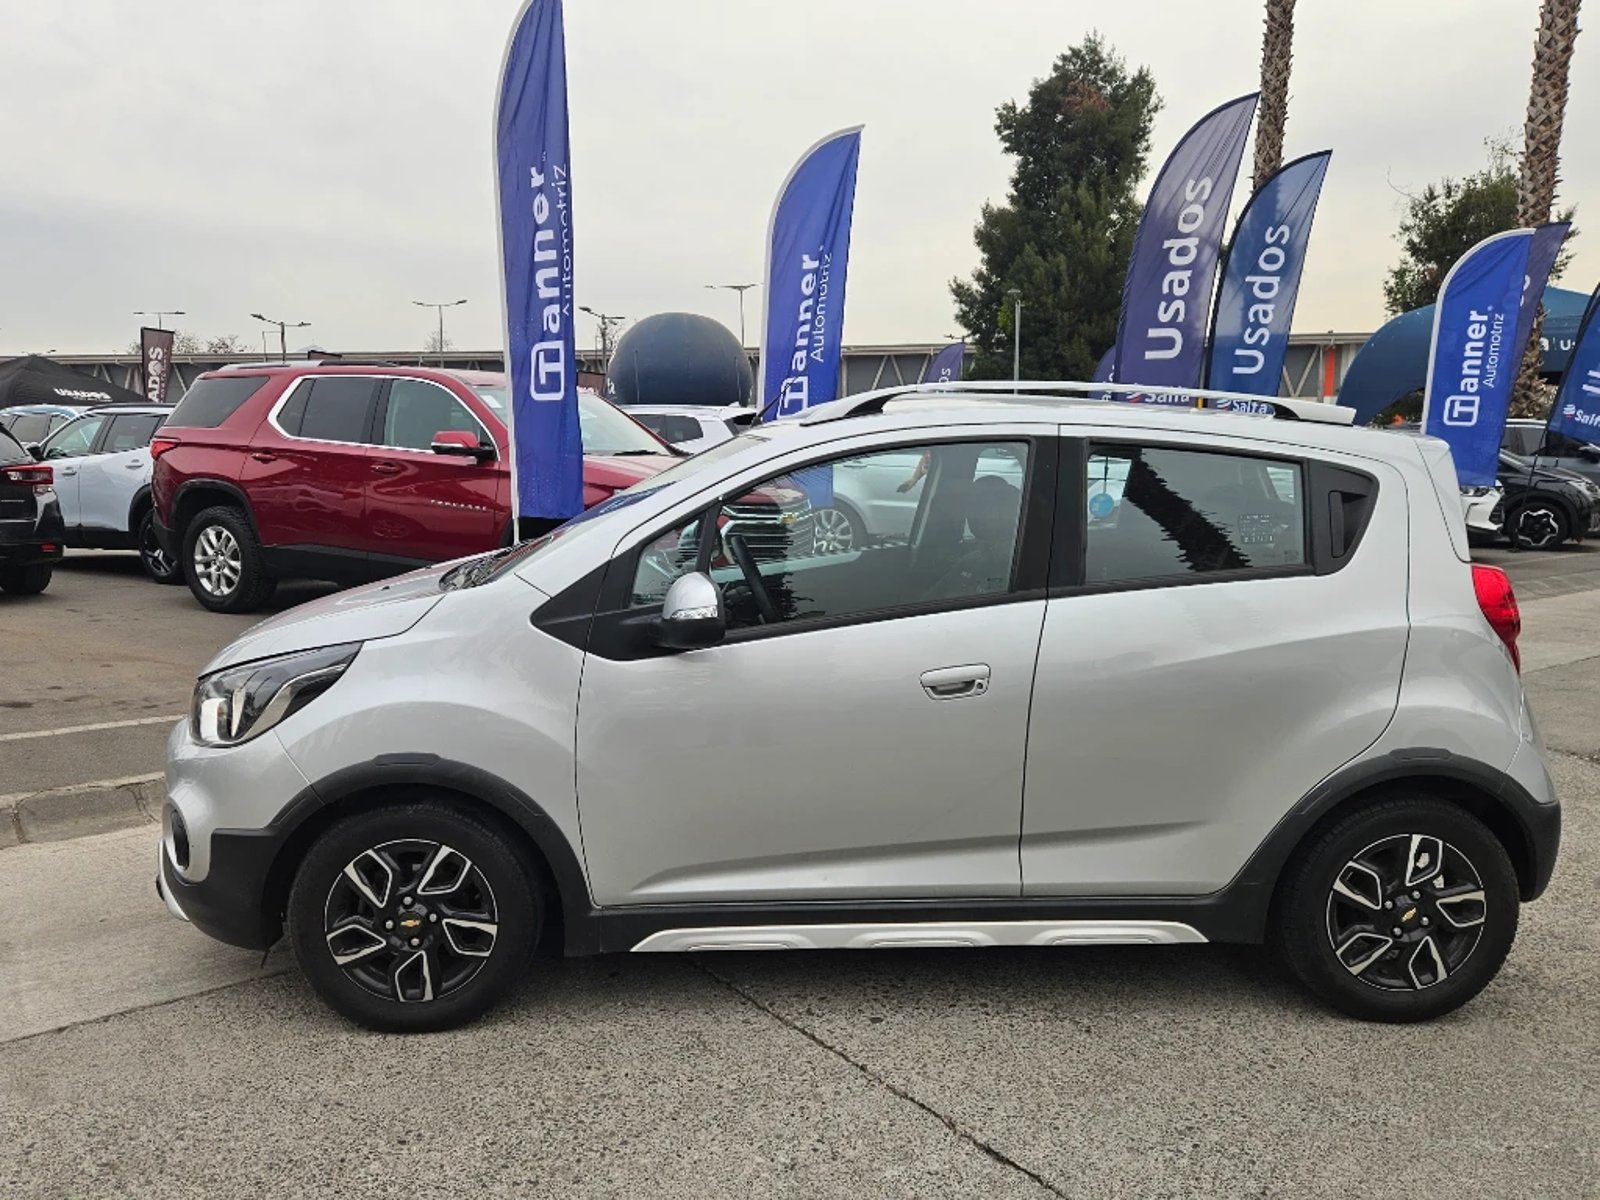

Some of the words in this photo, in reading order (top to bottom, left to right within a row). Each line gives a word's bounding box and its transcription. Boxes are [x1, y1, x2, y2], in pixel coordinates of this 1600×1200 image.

[529, 166, 566, 402] Tanner
[810, 252, 832, 363] Automotriz
[1144, 175, 1212, 361] Usados
[1232, 223, 1290, 376] Usados
[147, 346, 163, 403] ADOS
[1443, 310, 1488, 428] Tanner
[1482, 313, 1504, 388] Automotriz
[1575, 408, 1600, 428] Salf
